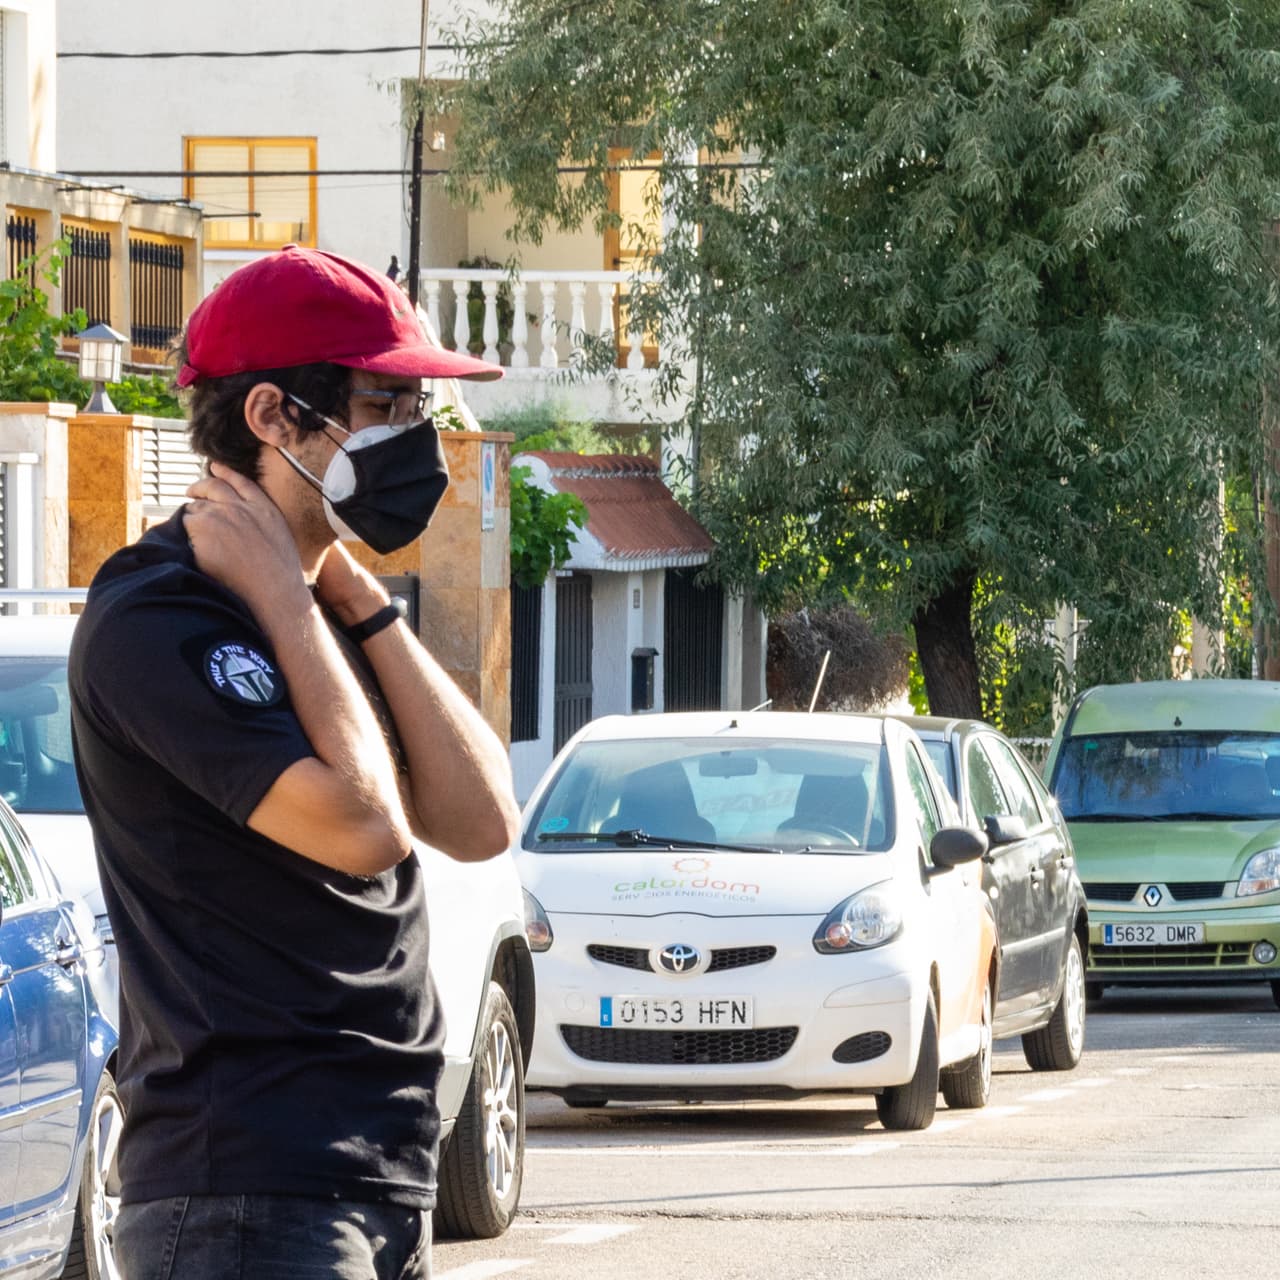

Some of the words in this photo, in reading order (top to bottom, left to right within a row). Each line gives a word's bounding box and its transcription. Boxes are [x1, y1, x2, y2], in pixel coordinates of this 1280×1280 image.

[211, 649, 223, 661] IS
[221, 644, 246, 655] THE
[210, 661, 226, 688] THIS
[1115, 925, 1156, 942] 5632
[1166, 925, 1197, 942] DMR
[620, 1000, 684, 1024] 0153
[699, 1000, 747, 1024] HFN
